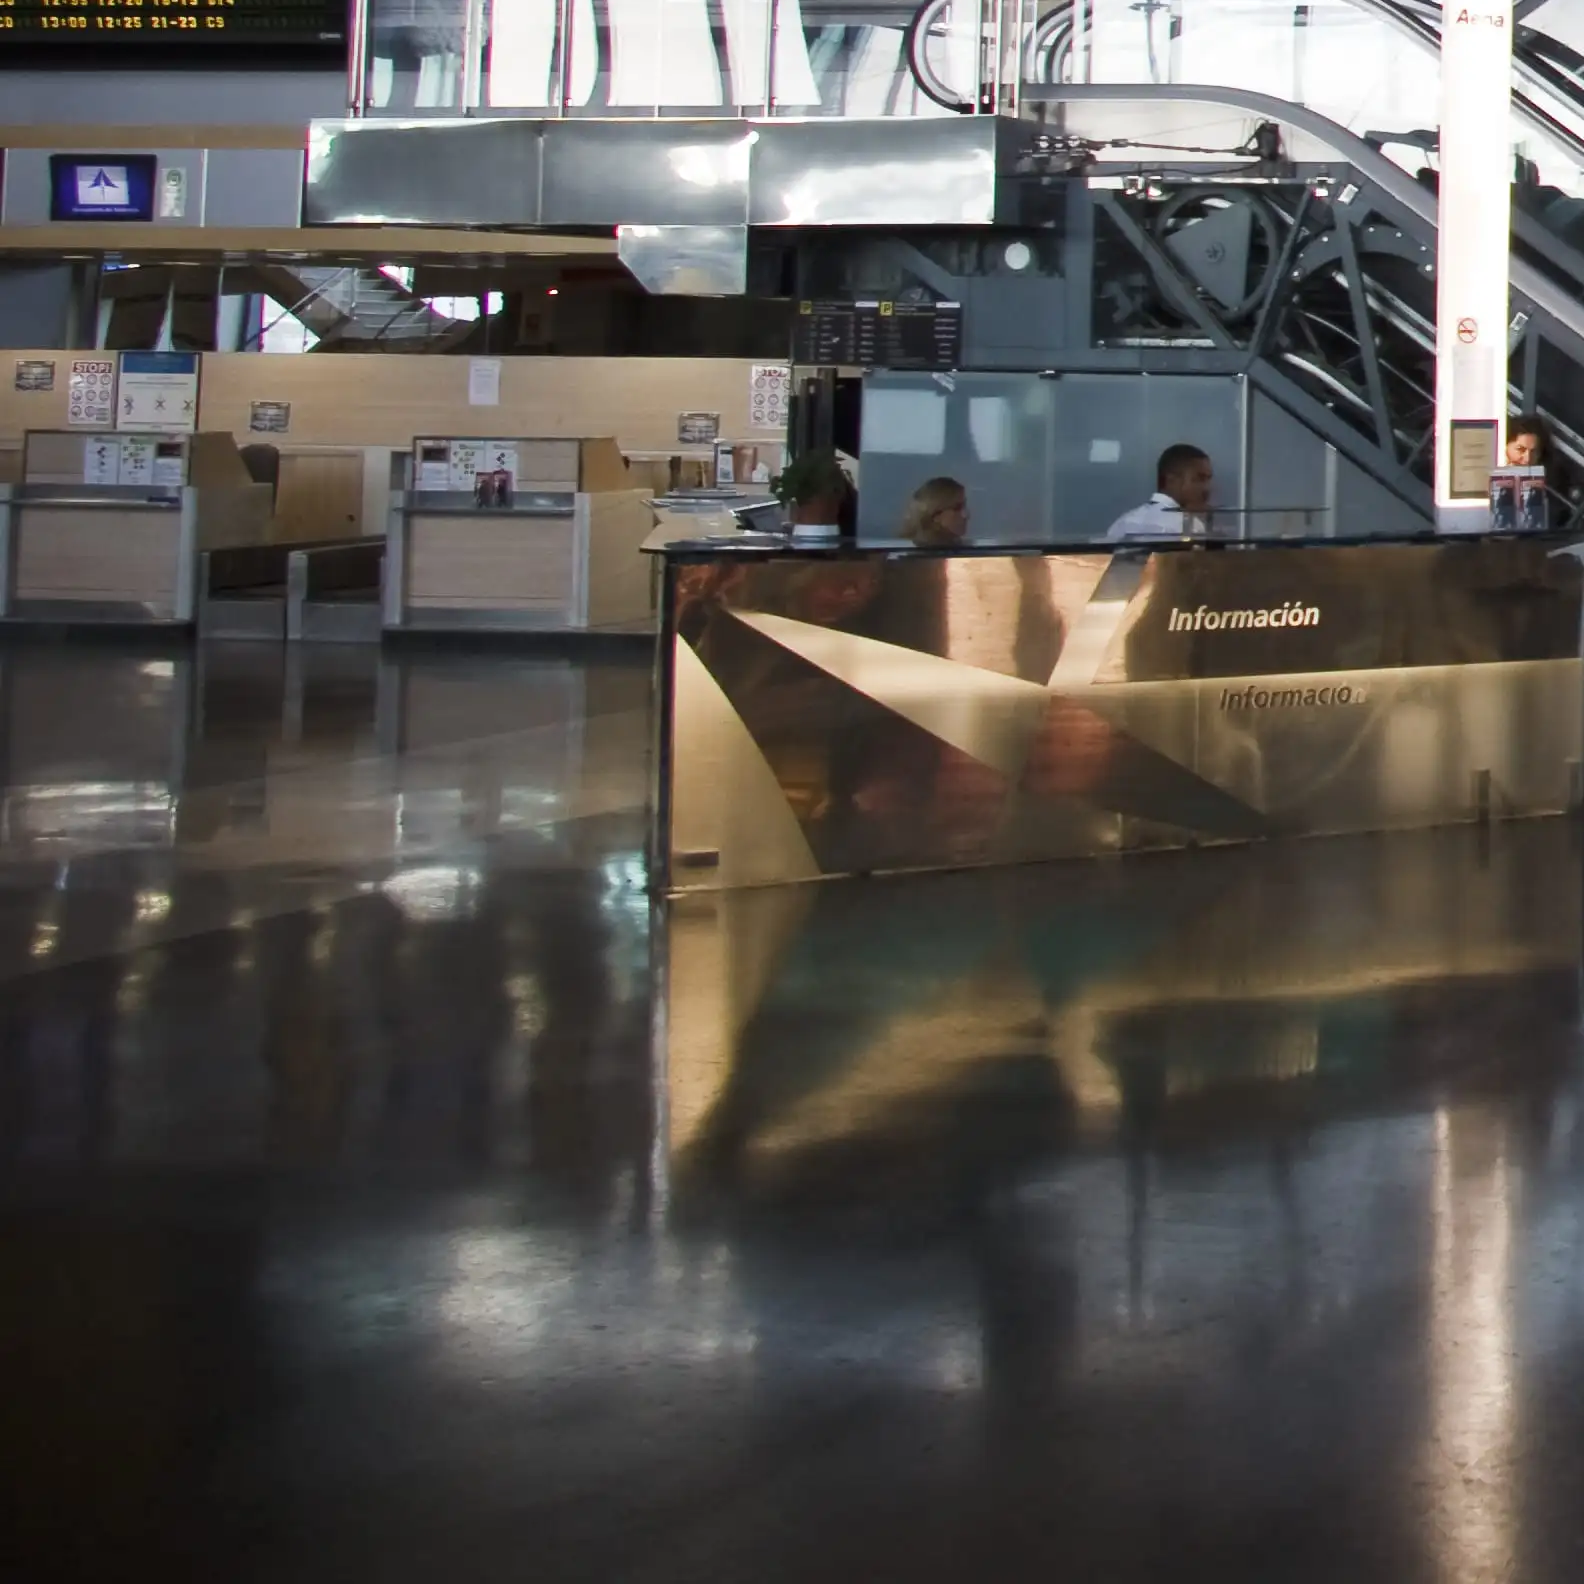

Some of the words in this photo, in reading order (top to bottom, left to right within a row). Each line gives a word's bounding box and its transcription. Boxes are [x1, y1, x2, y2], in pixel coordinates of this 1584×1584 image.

[41, 16, 87, 29] 13:00
[95, 16, 142, 29] 12:25
[151, 16, 198, 29] 21-23
[1456, 9, 1504, 27] Aena
[1168, 602, 1320, 632] Información
